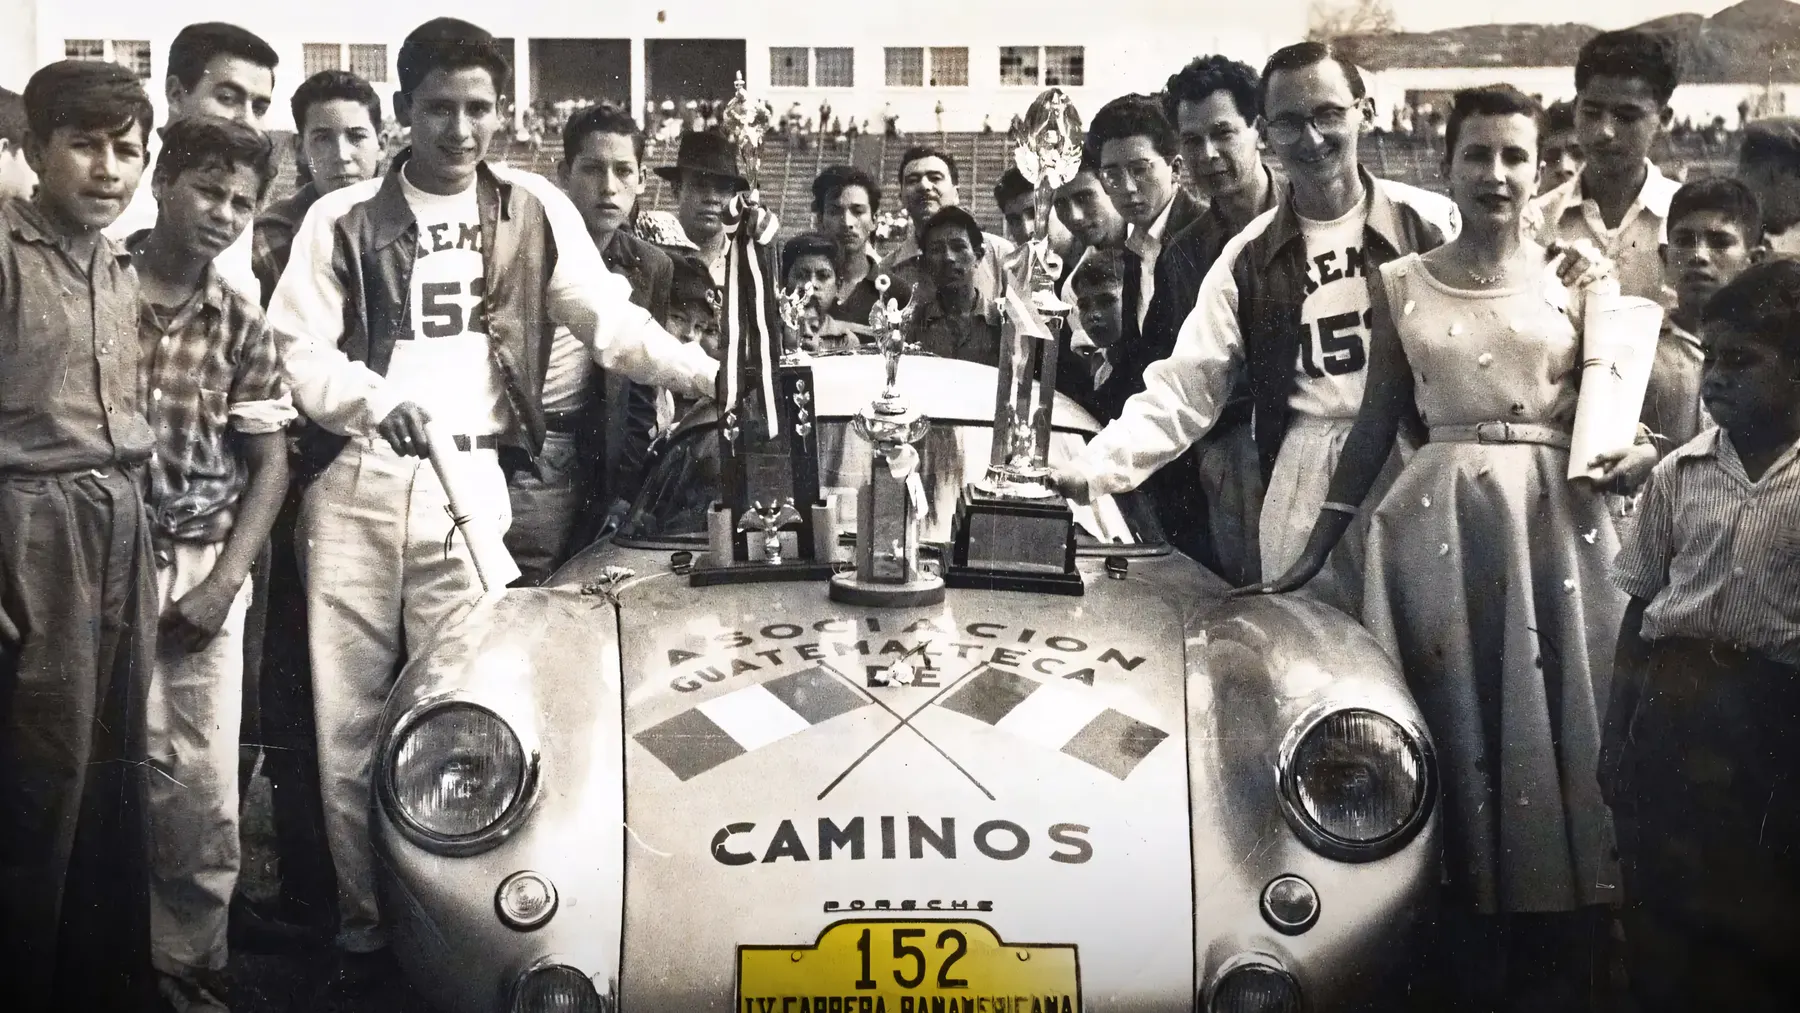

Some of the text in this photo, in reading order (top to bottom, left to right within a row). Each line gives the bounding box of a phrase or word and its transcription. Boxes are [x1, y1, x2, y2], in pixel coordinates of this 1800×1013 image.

[416, 222, 482, 260] EM
[1299, 308, 1373, 378] 15
[667, 616, 1147, 672] ASOCIACION
[669, 639, 1096, 693] GUATEMALTECA
[710, 816, 1094, 867] CAMINOS
[824, 899, 994, 913] PORSCHE
[855, 928, 969, 990] 152
